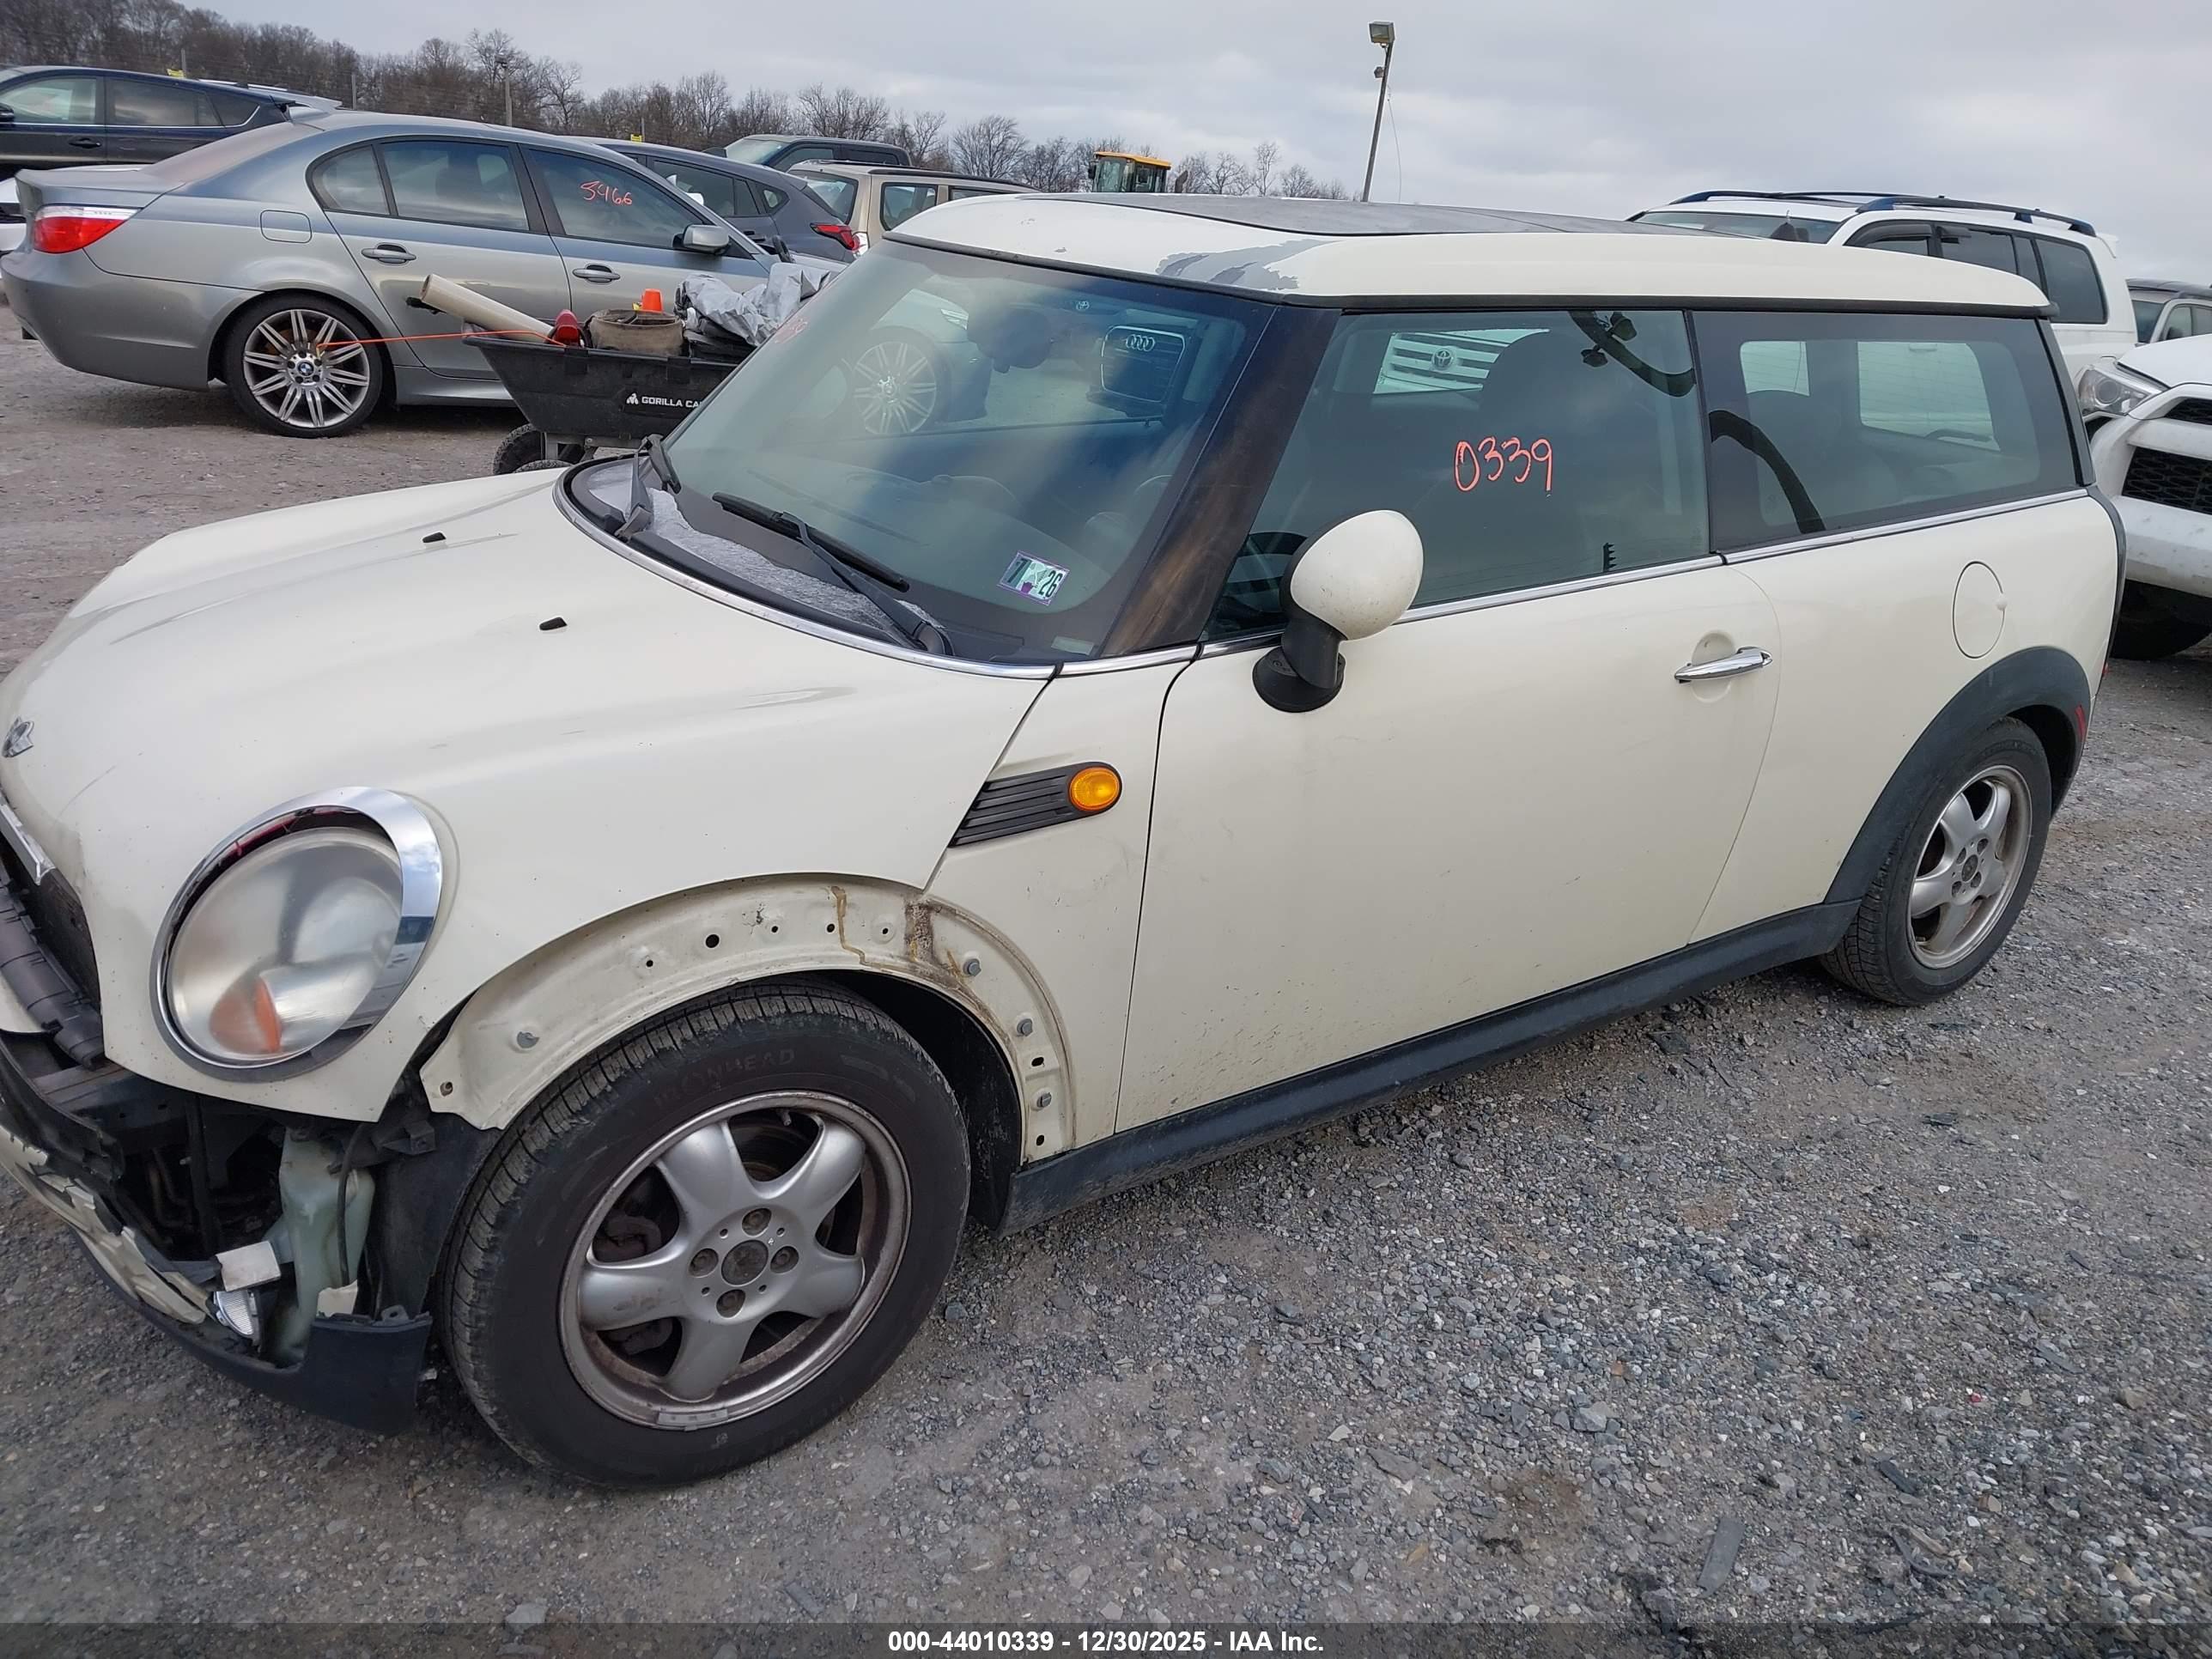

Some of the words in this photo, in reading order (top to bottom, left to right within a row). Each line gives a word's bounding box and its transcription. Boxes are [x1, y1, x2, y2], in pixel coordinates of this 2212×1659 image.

[641, 396, 684, 407] GORILLA
[685, 399, 702, 409] CA
[1455, 436, 1553, 491] 0339
[1038, 570, 1063, 598] 26
